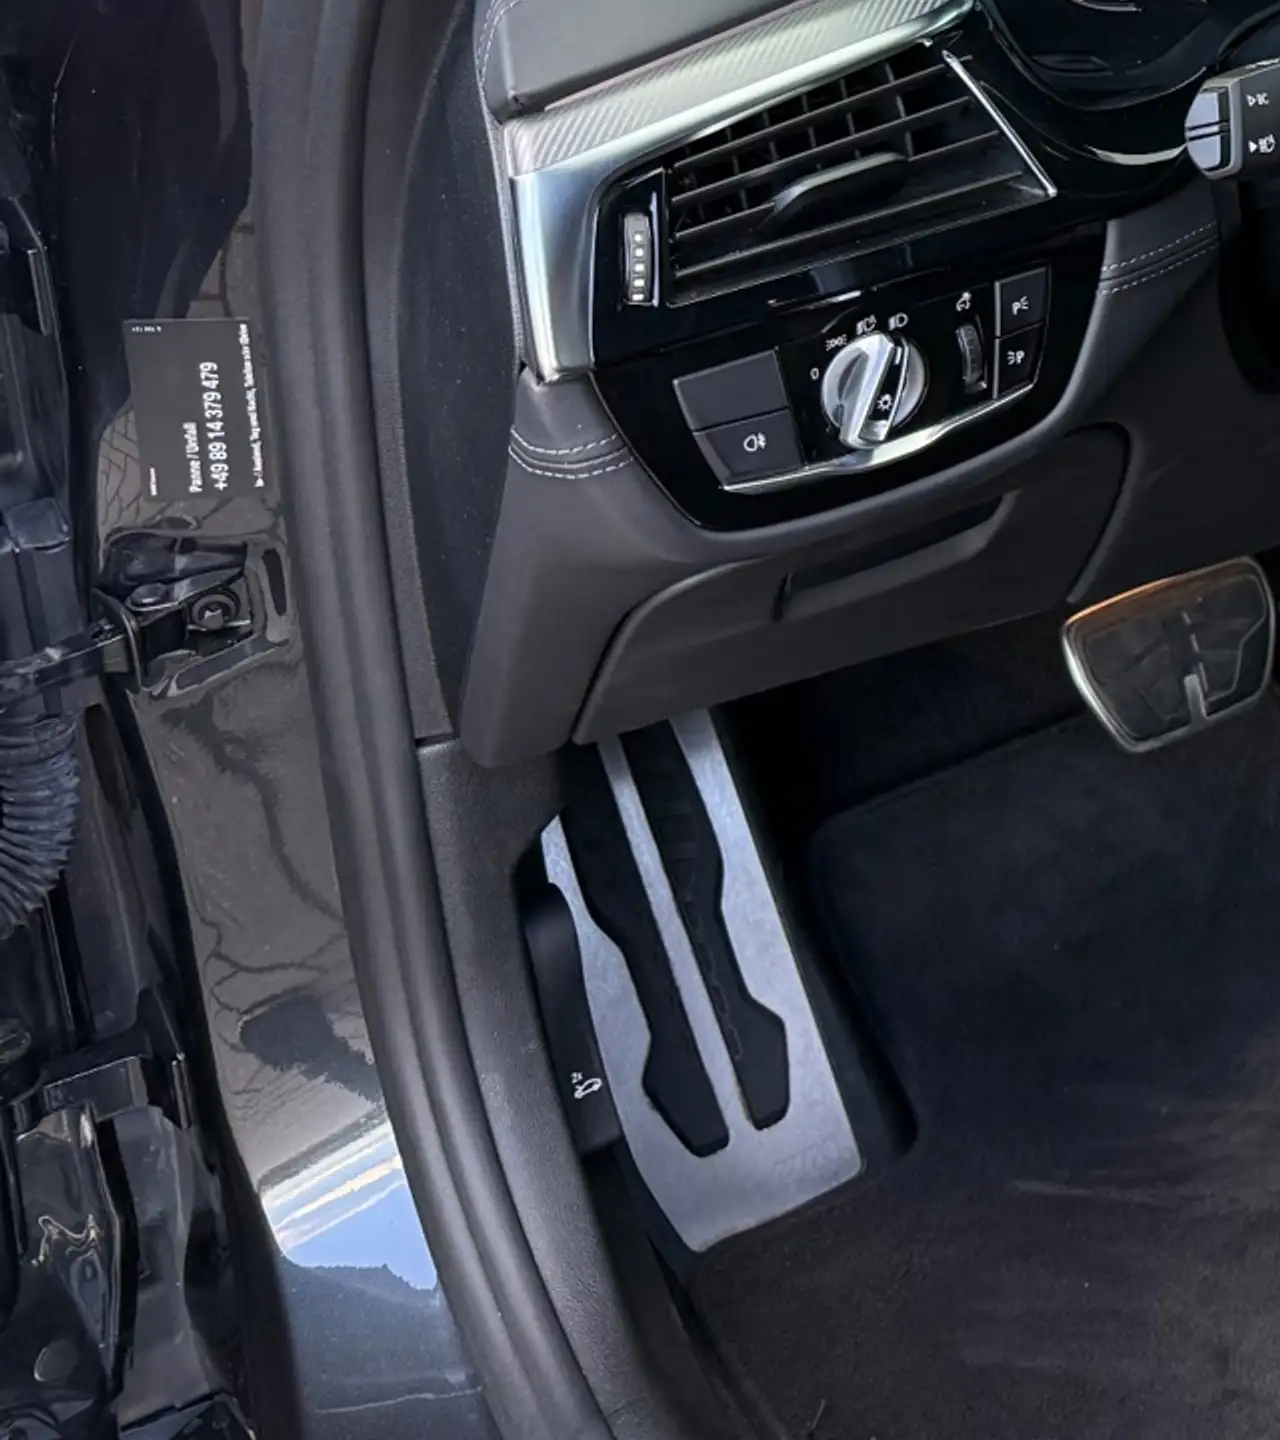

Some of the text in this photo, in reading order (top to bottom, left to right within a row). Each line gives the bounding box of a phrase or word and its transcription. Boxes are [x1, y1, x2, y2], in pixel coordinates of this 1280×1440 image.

[183, 422, 199, 453] Unfall
[199, 361, 230, 491] +49 89 14 379 479
[189, 460, 203, 493] Panne
